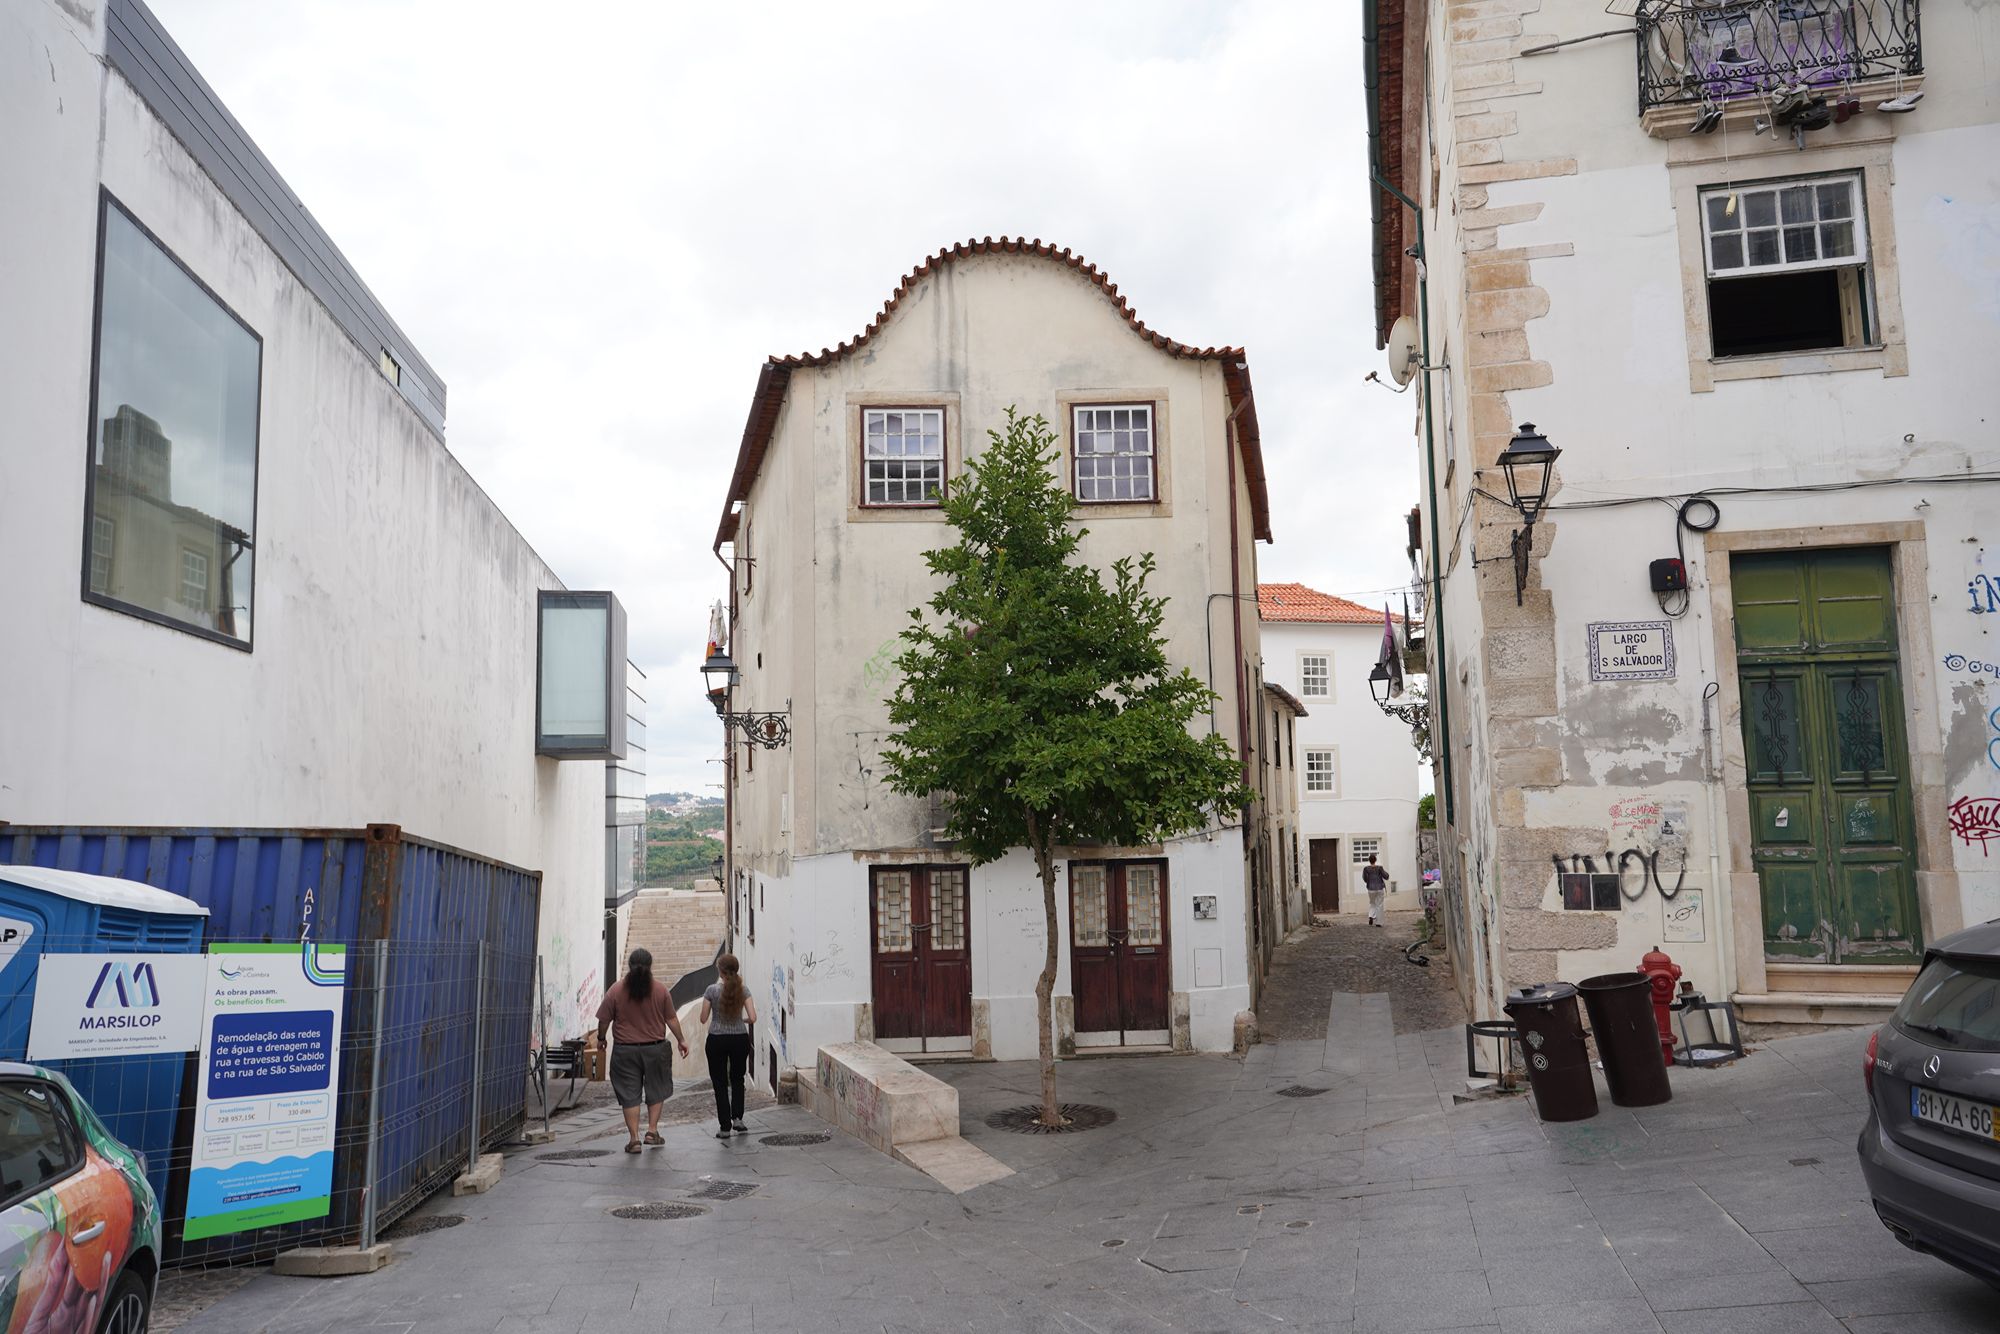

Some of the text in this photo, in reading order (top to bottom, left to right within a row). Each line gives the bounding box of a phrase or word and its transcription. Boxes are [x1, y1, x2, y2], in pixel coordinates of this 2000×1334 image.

[1613, 633, 1647, 645] LARGO
[1625, 645, 1638, 655] DE
[1602, 655, 1663, 667] S SALVADOR
[300, 887, 315, 944] APZ
[215, 988, 278, 999] As obras passam.
[214, 999, 225, 1007] Os
[265, 997, 287, 1005] ficam.
[79, 1014, 161, 1030] MARSILOP
[217, 1029, 321, 1043] Remodelação das redes
[216, 1041, 321, 1056] de água e drenagem na
[215, 1051, 325, 1067] rua e travessa do Cabido
[214, 1062, 326, 1080] e na rua de São Salvador
